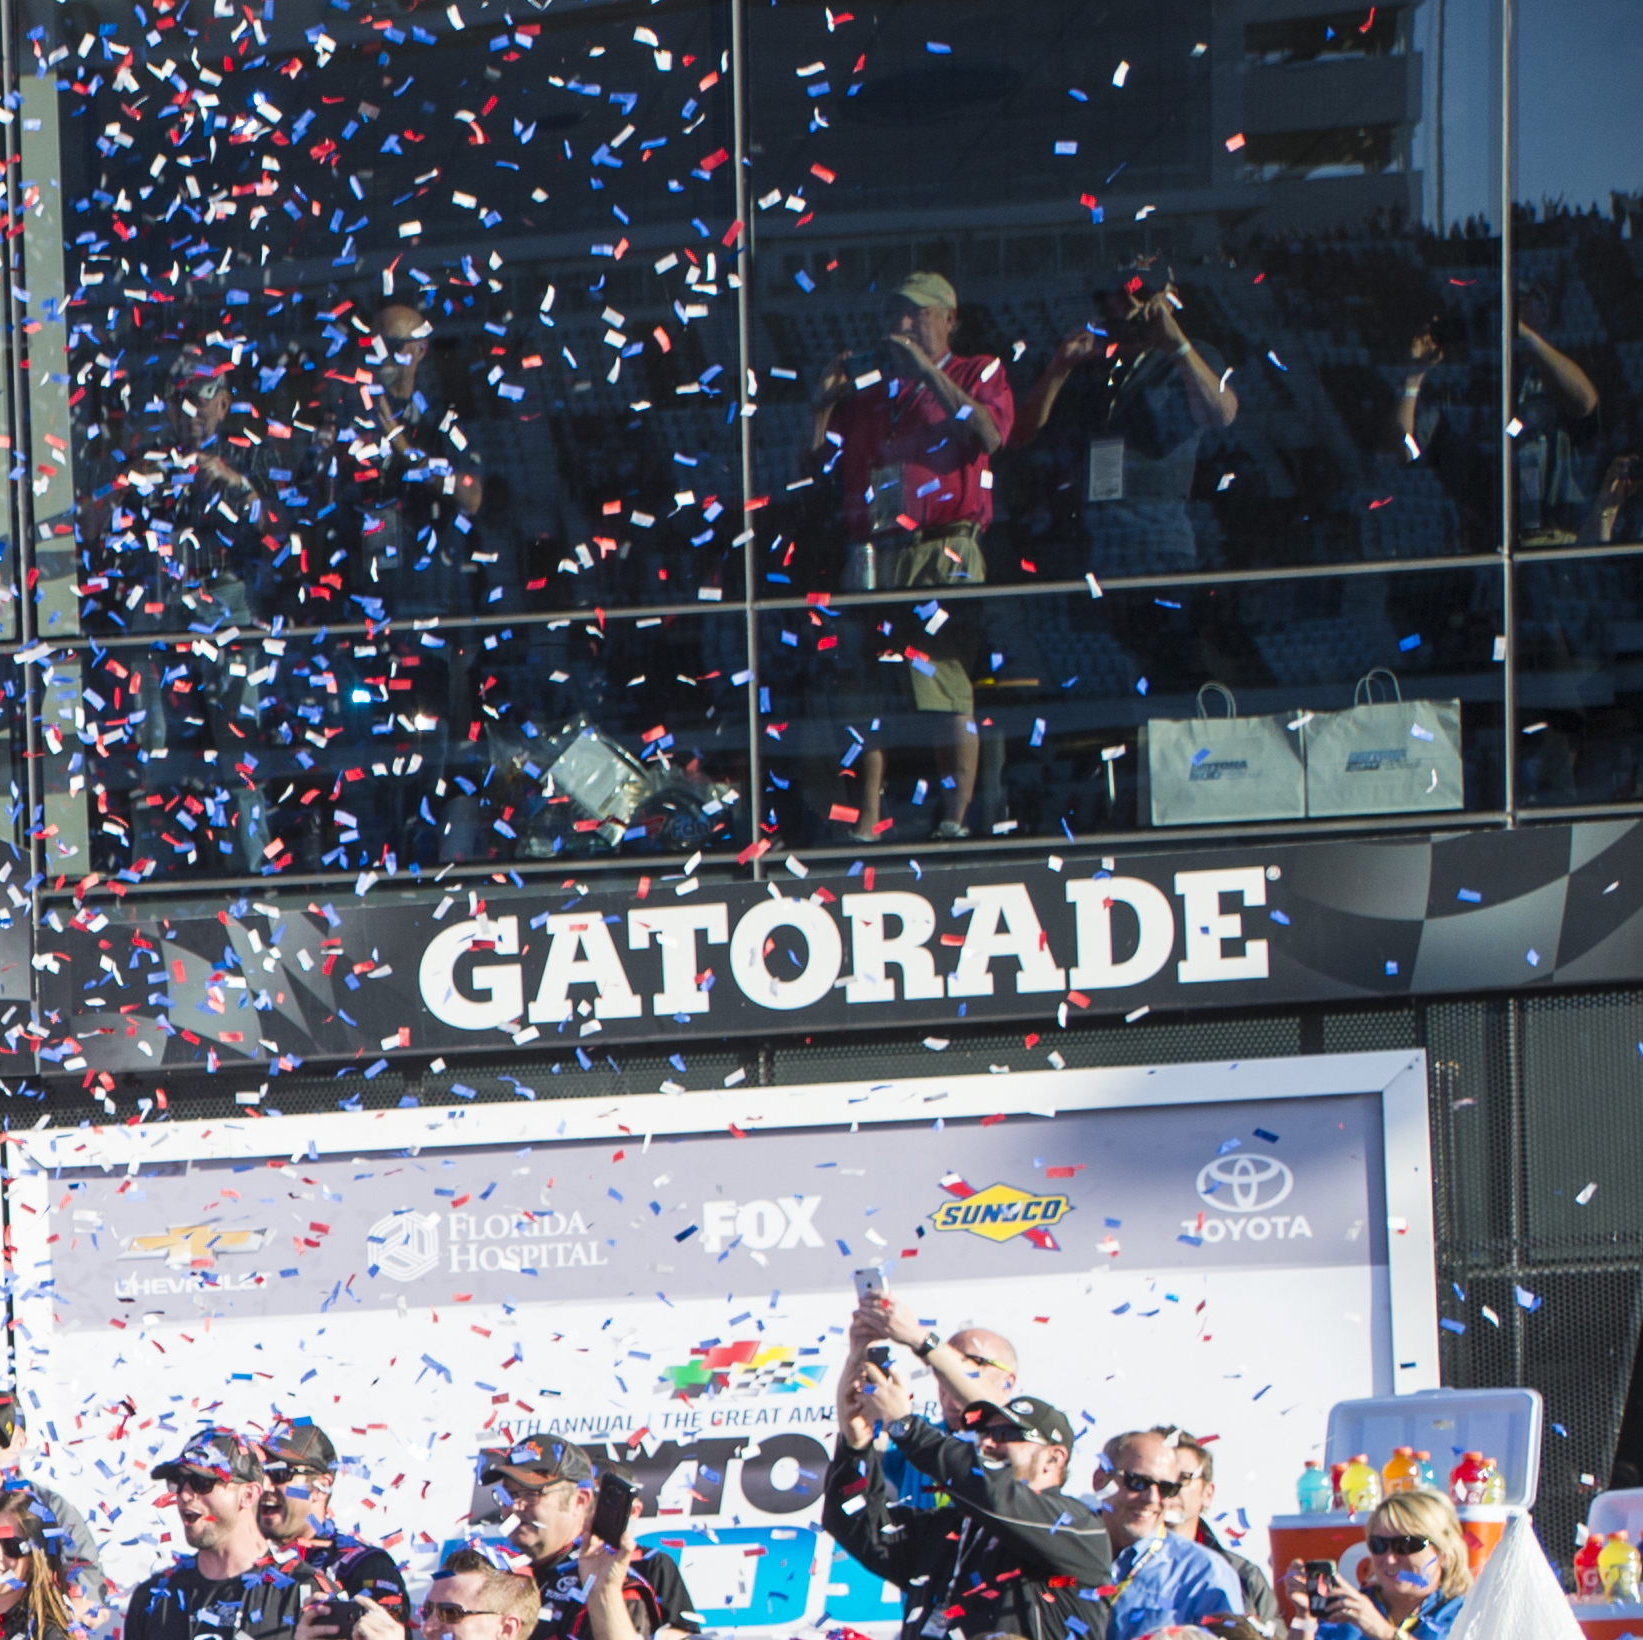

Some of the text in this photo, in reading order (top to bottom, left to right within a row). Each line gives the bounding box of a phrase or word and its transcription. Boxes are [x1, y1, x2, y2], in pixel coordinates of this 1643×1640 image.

[419, 866, 1270, 1030] GATORADE
[448, 1209, 588, 1240] FLORIDA
[703, 1196, 825, 1253] FOX
[937, 1195, 1063, 1228] SUNOCO
[1181, 1215, 1313, 1243] TOYOTA
[448, 1240, 609, 1274] HOSPITAL
[556, 1413, 635, 1435] ANNUAL
[661, 1411, 702, 1429] THE
[709, 1407, 782, 1428] GREAT
